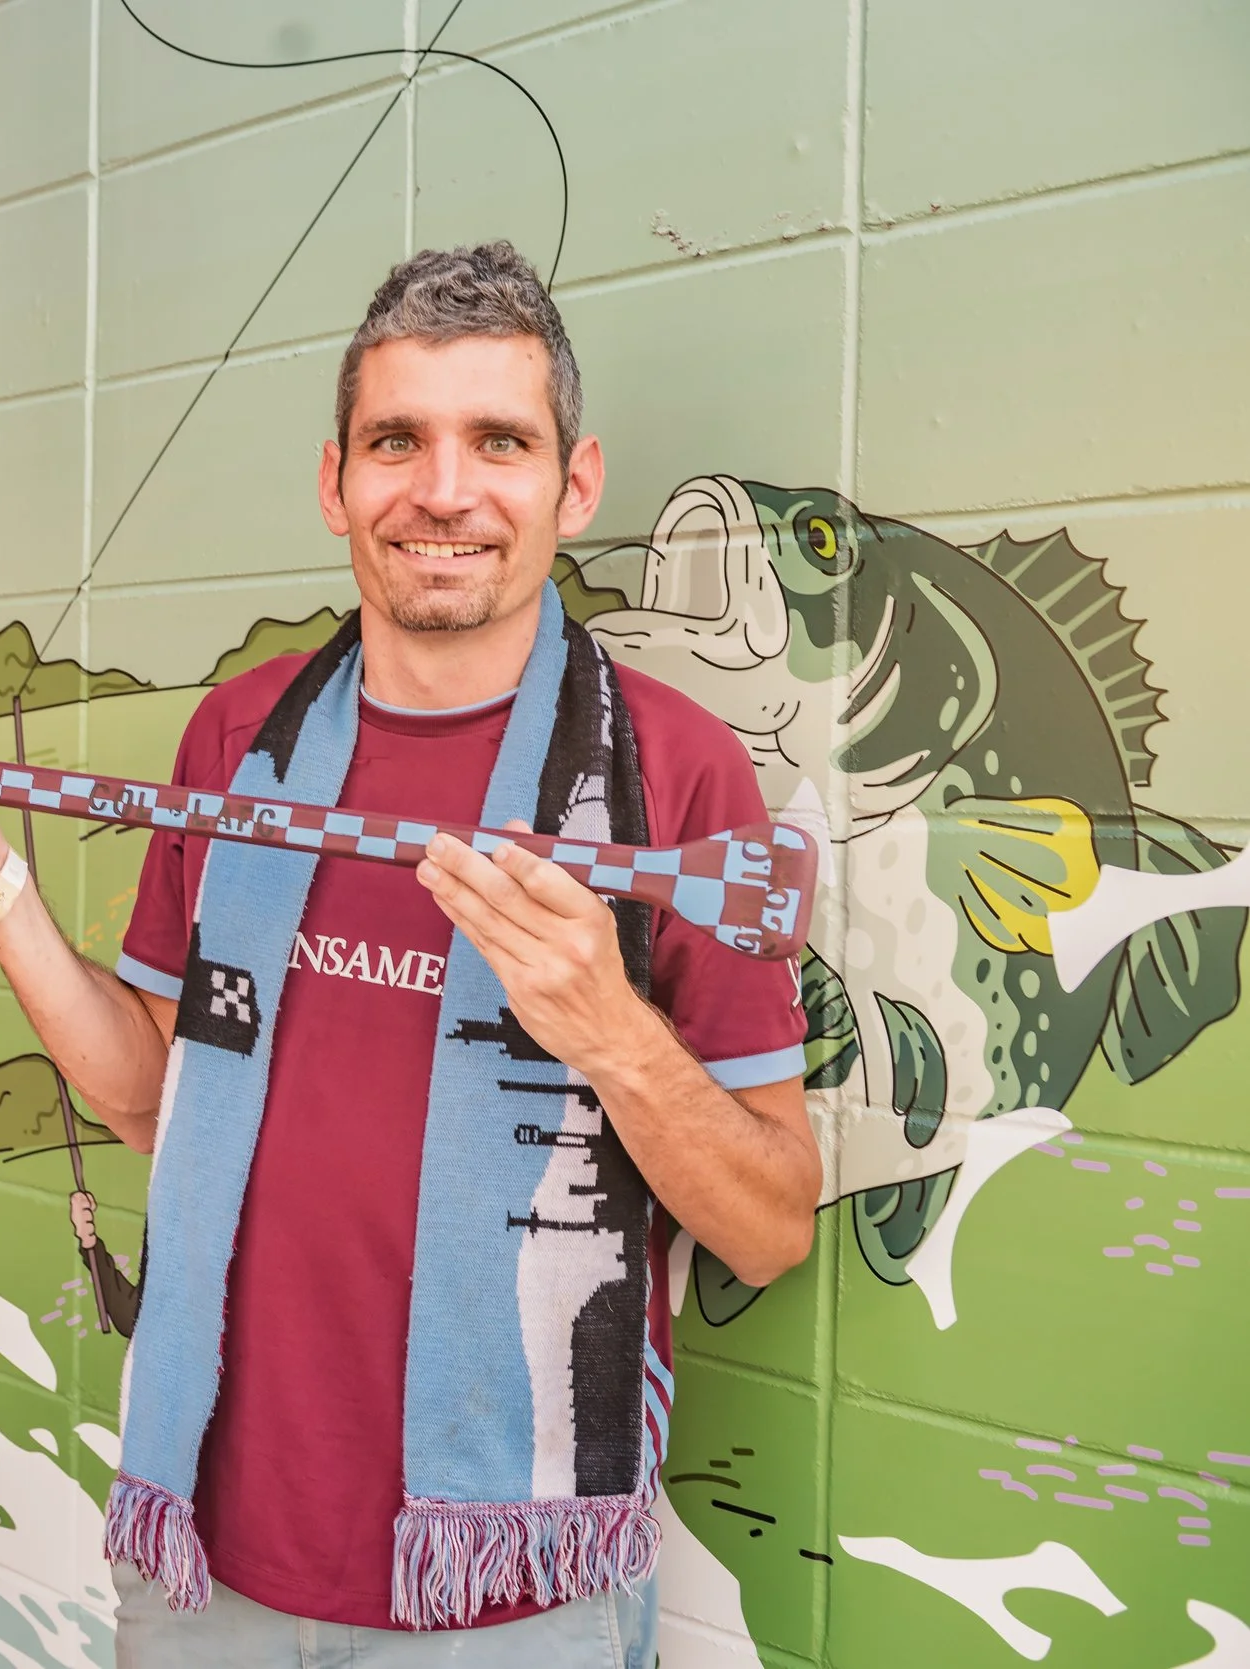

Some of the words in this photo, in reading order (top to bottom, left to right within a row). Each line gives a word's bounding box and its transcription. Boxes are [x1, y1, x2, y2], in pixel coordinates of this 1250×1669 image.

[87, 782, 153, 820] COL
[193, 797, 278, 839] LAFC
[288, 931, 446, 996] NSAME
